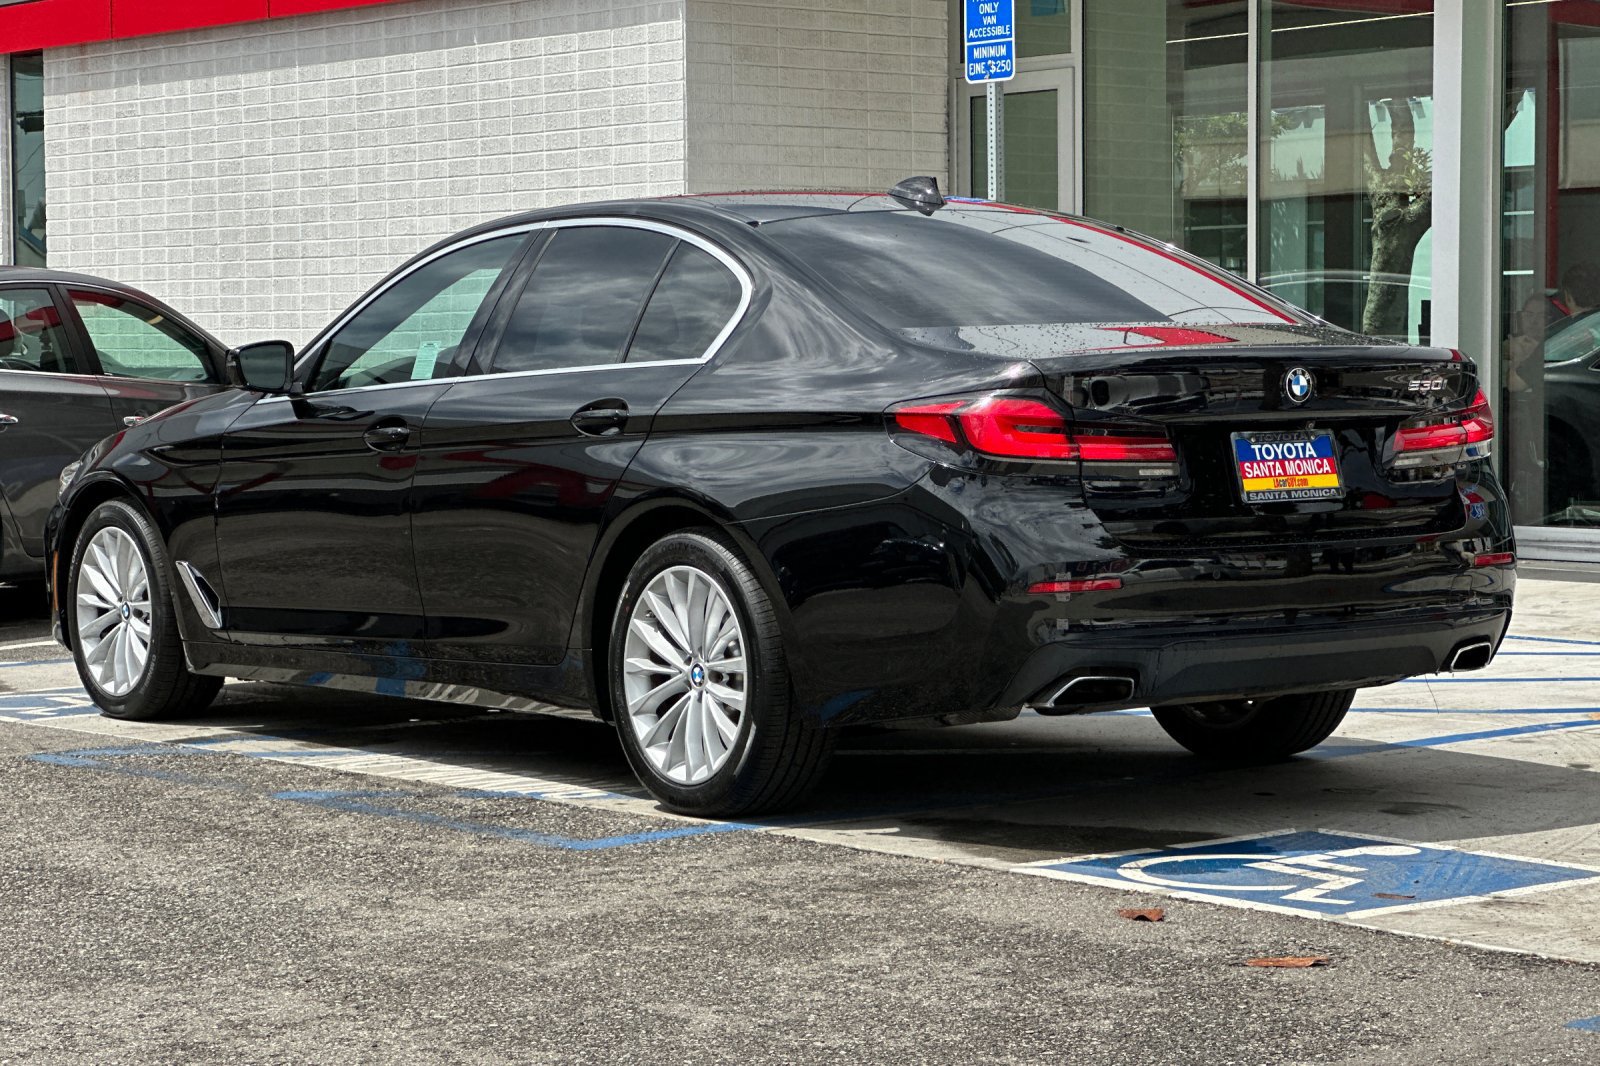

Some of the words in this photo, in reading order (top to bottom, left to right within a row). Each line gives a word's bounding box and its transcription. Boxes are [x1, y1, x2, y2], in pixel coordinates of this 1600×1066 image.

[979, 2, 999, 14] ONLY
[983, 15, 996, 25] VAN
[969, 25, 1010, 38] ACCESSIBLE
[973, 45, 1006, 59] MINIMUM
[989, 59, 1011, 74] $250
[1256, 433, 1308, 441] TOYOTA
[1251, 442, 1317, 460] TOYOTA
[1244, 462, 1283, 478] SANTA
[1285, 459, 1331, 475] MONICA
[1249, 491, 1289, 501] SANTA
[1291, 488, 1337, 499] MONICA
